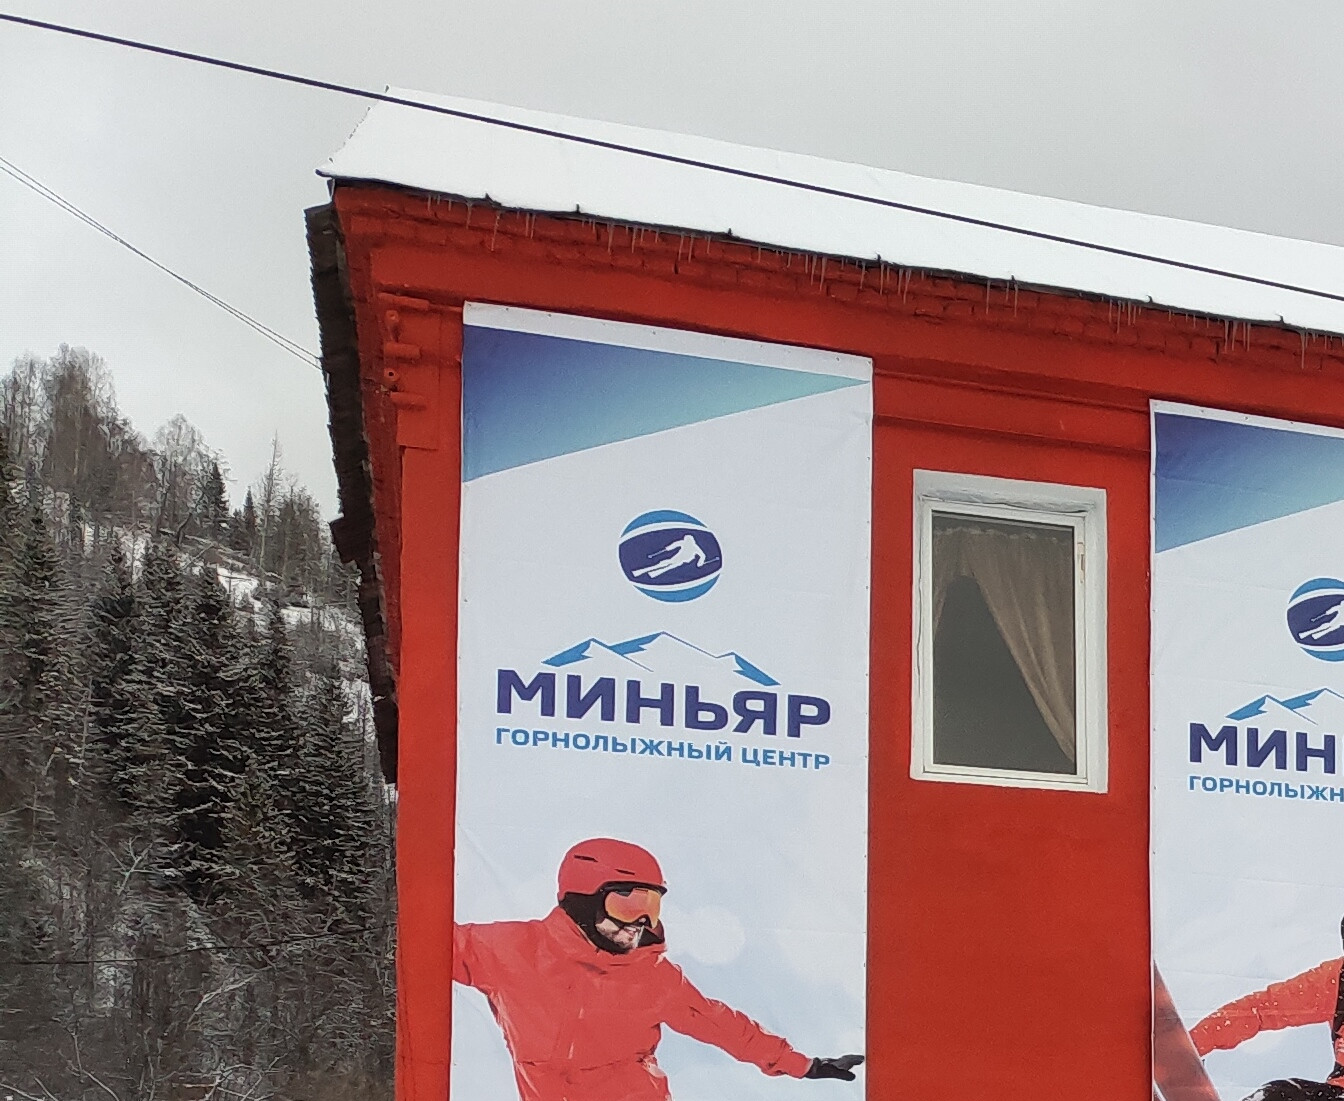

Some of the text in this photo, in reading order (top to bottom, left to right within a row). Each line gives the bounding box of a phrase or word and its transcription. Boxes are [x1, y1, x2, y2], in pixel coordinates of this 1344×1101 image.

[497, 669, 831, 738] МИНЬЯР
[496, 727, 830, 770] ГОРНОЛЫЖНЫЙ ЦЕНТР
